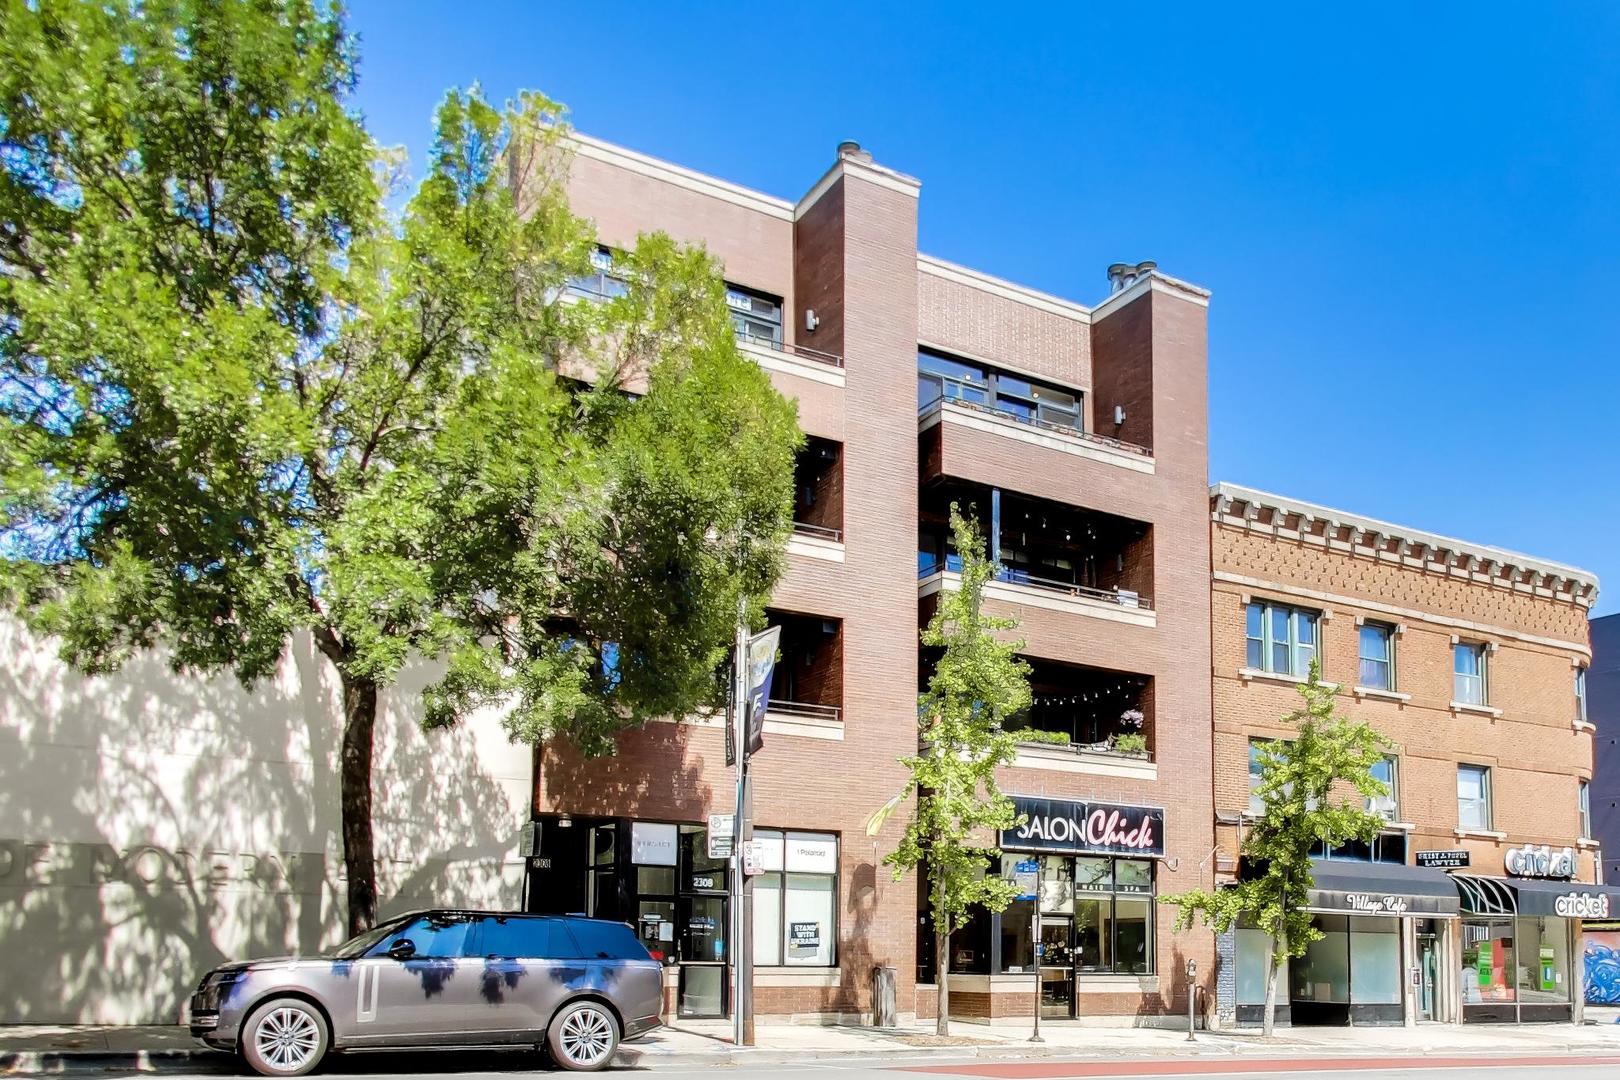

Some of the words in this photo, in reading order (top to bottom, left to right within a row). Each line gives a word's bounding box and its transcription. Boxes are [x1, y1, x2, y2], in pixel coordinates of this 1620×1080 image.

[1017, 813, 1086, 842] SALON
[1087, 809, 1154, 849] Chick
[1346, 894, 1383, 915] Village
[1555, 892, 1609, 918] cricket
